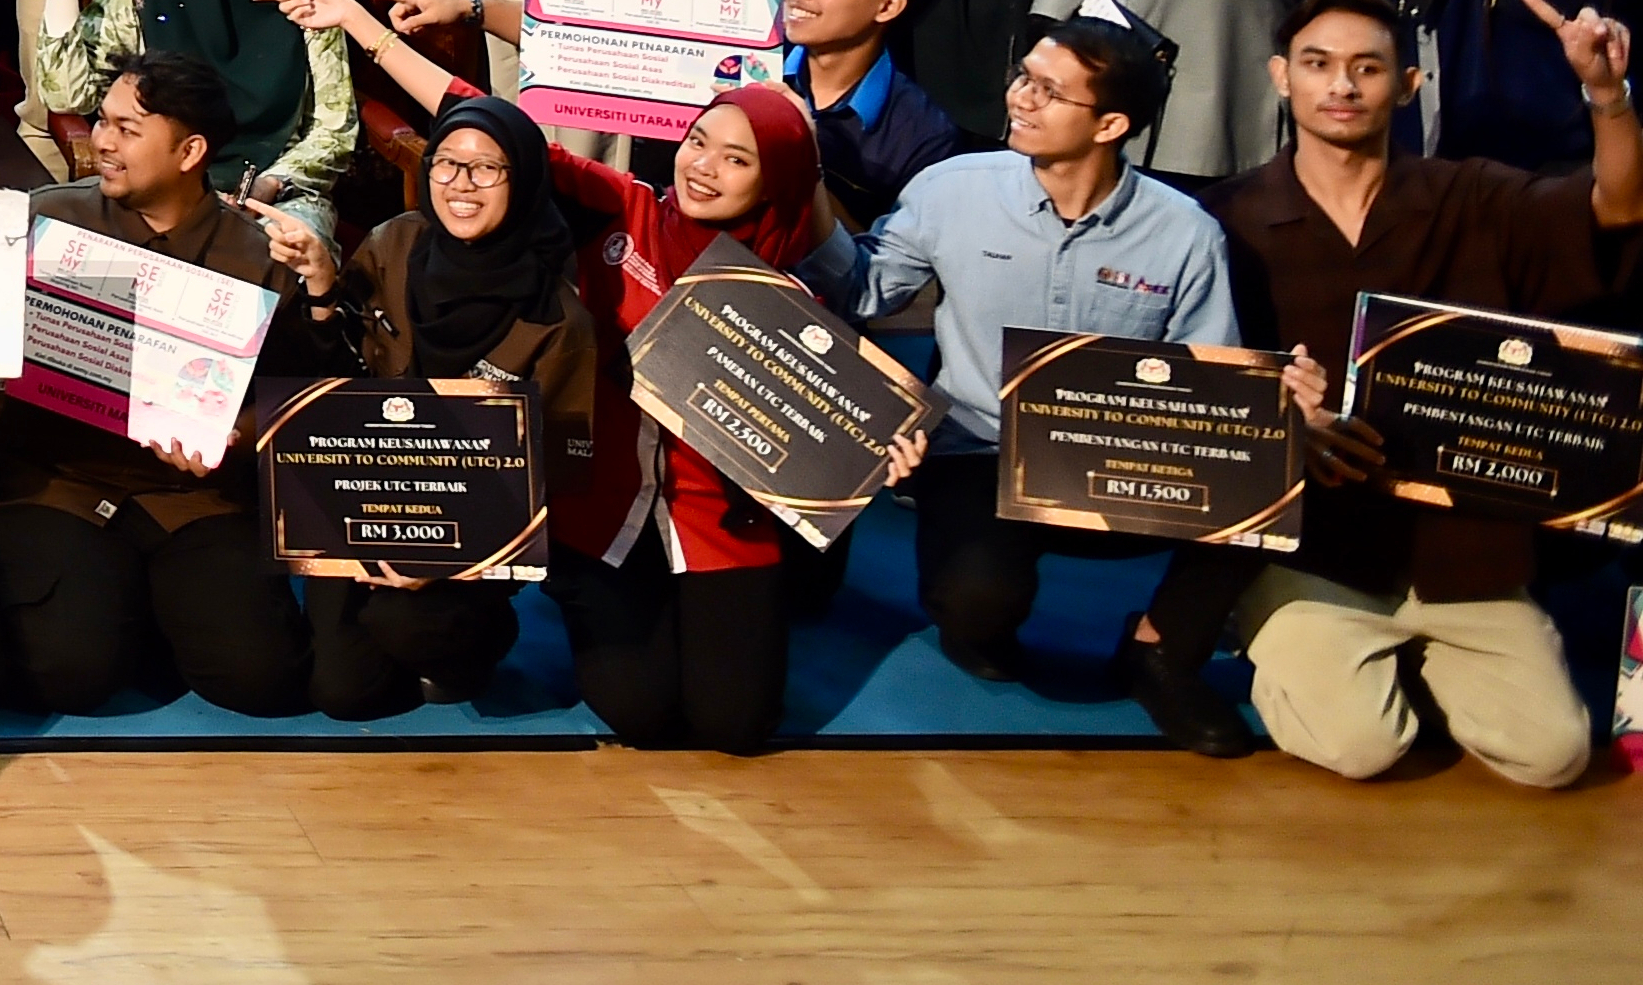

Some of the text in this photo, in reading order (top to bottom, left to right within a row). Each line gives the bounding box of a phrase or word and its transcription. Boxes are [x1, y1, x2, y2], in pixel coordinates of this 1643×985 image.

[540, 29, 705, 58] PERMOHONAN PENARAFAN
[554, 103, 673, 128] UNIVERSITI UTARA
[25, 295, 178, 355] PERMOHONAN PENARAFAN
[31, 324, 130, 363] Perusahaan Sosial Asas
[37, 383, 107, 416] UNIVERSITI
[713, 379, 791, 444] TEMPAT PERTAMA
[701, 398, 772, 456] RM 2,500
[276, 452, 525, 469] UNIVERSITY TO COMMUNITY (UTC) 2.0
[1452, 455, 1543, 486] RM 2,000
[334, 479, 467, 493] PROJEK UTC TERBAIK
[1107, 479, 1135, 496] RM
[361, 503, 442, 515] TEMPAT KEDUA
[361, 524, 445, 540] RM 3,000
